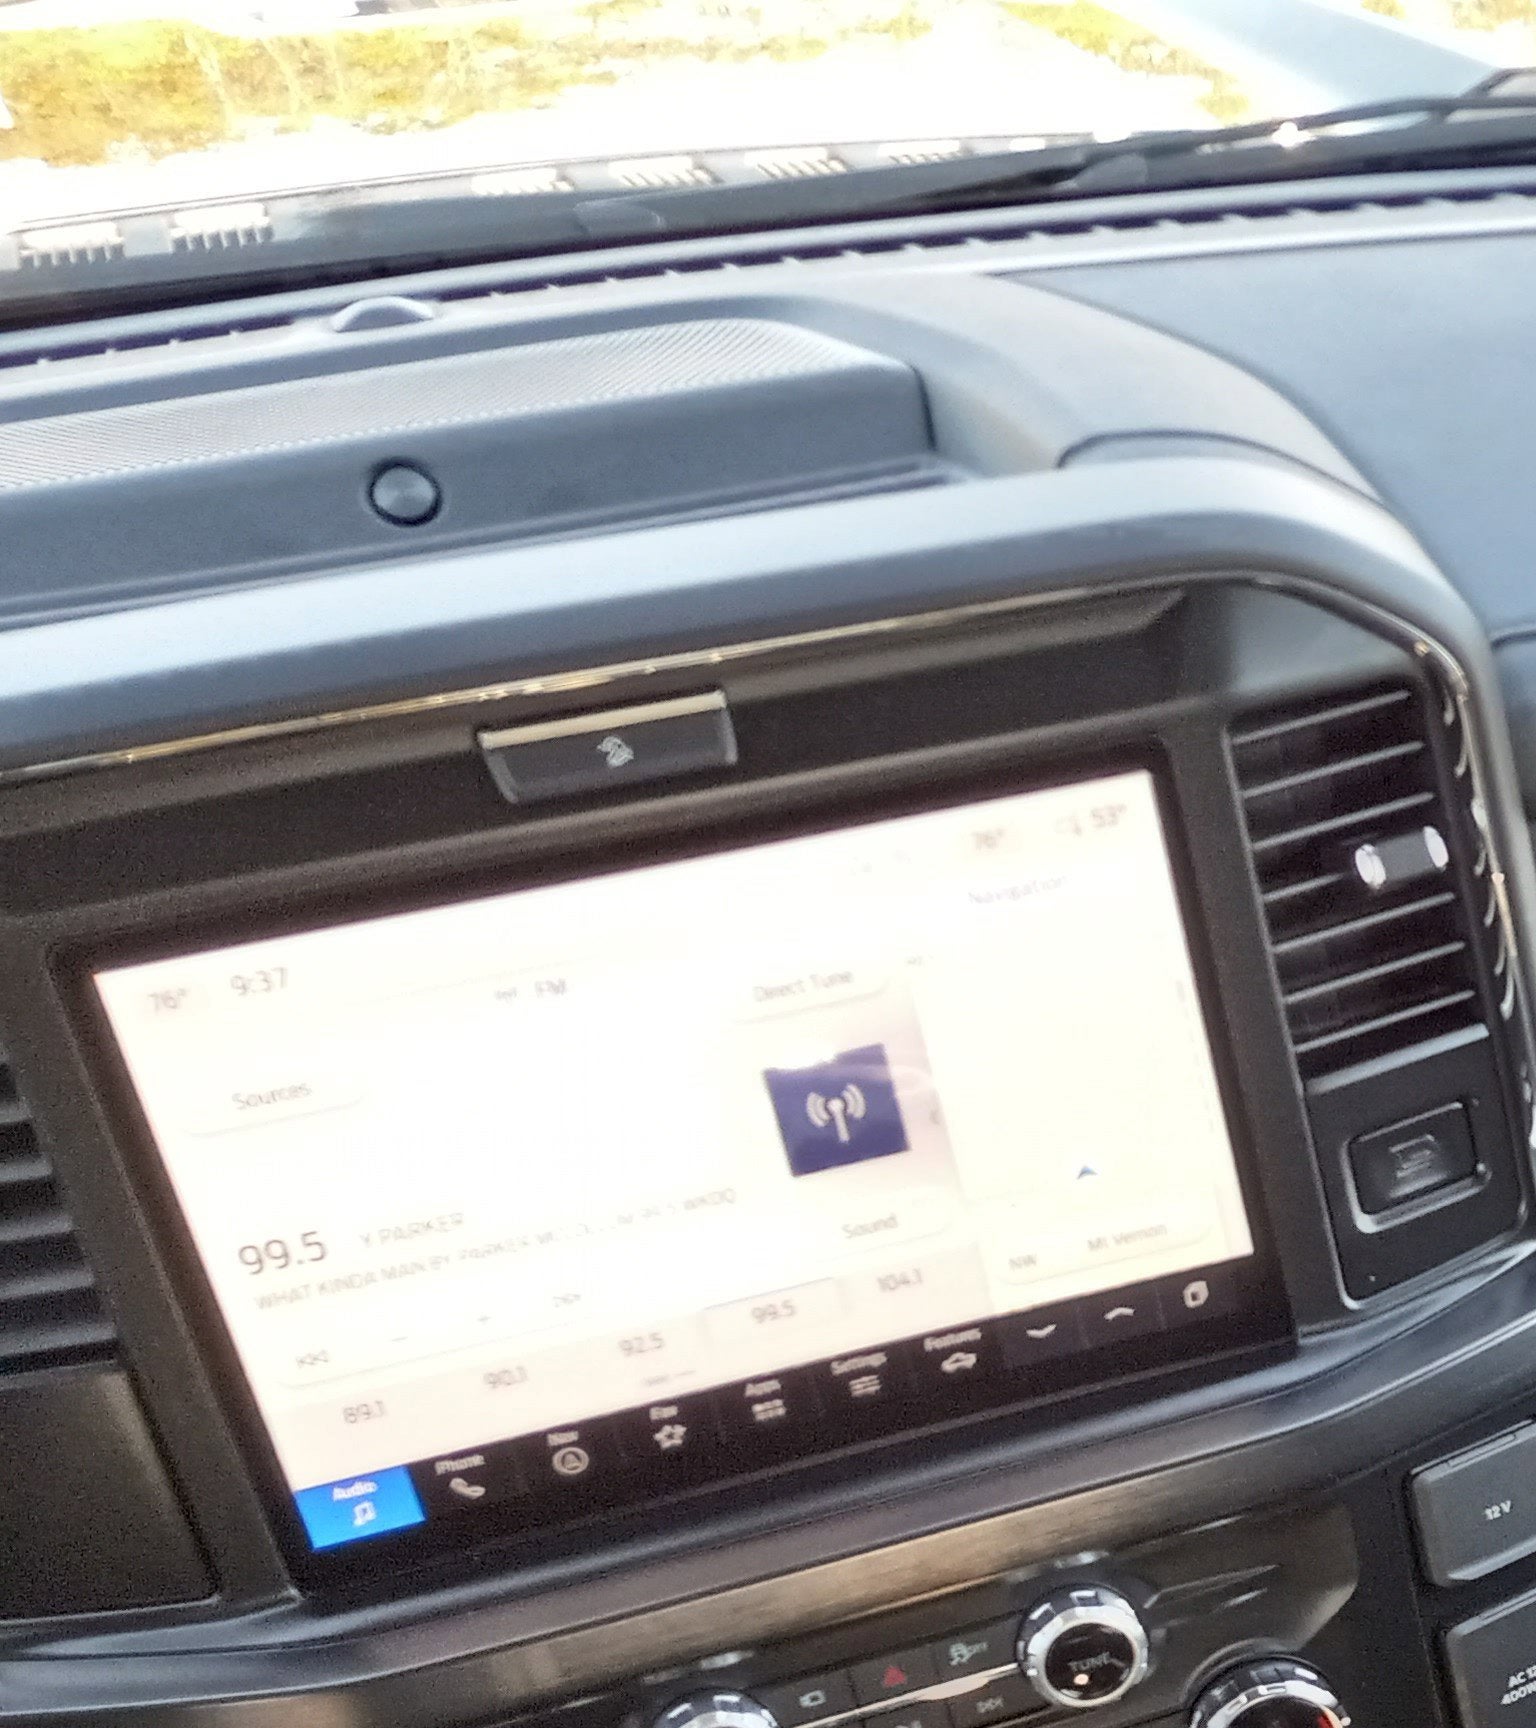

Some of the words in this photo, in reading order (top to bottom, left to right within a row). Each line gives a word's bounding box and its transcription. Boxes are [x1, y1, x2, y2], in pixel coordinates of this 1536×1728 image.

[230, 967, 289, 997] 9:37
[231, 1081, 313, 1110] Sources
[842, 1214, 899, 1239] Sound
[237, 1230, 329, 1276] 99.5
[750, 1300, 797, 1325] 99.5
[617, 1331, 667, 1357] 92.5
[333, 1480, 378, 1501] Audio
[1508, 1671, 1526, 1689] AC
